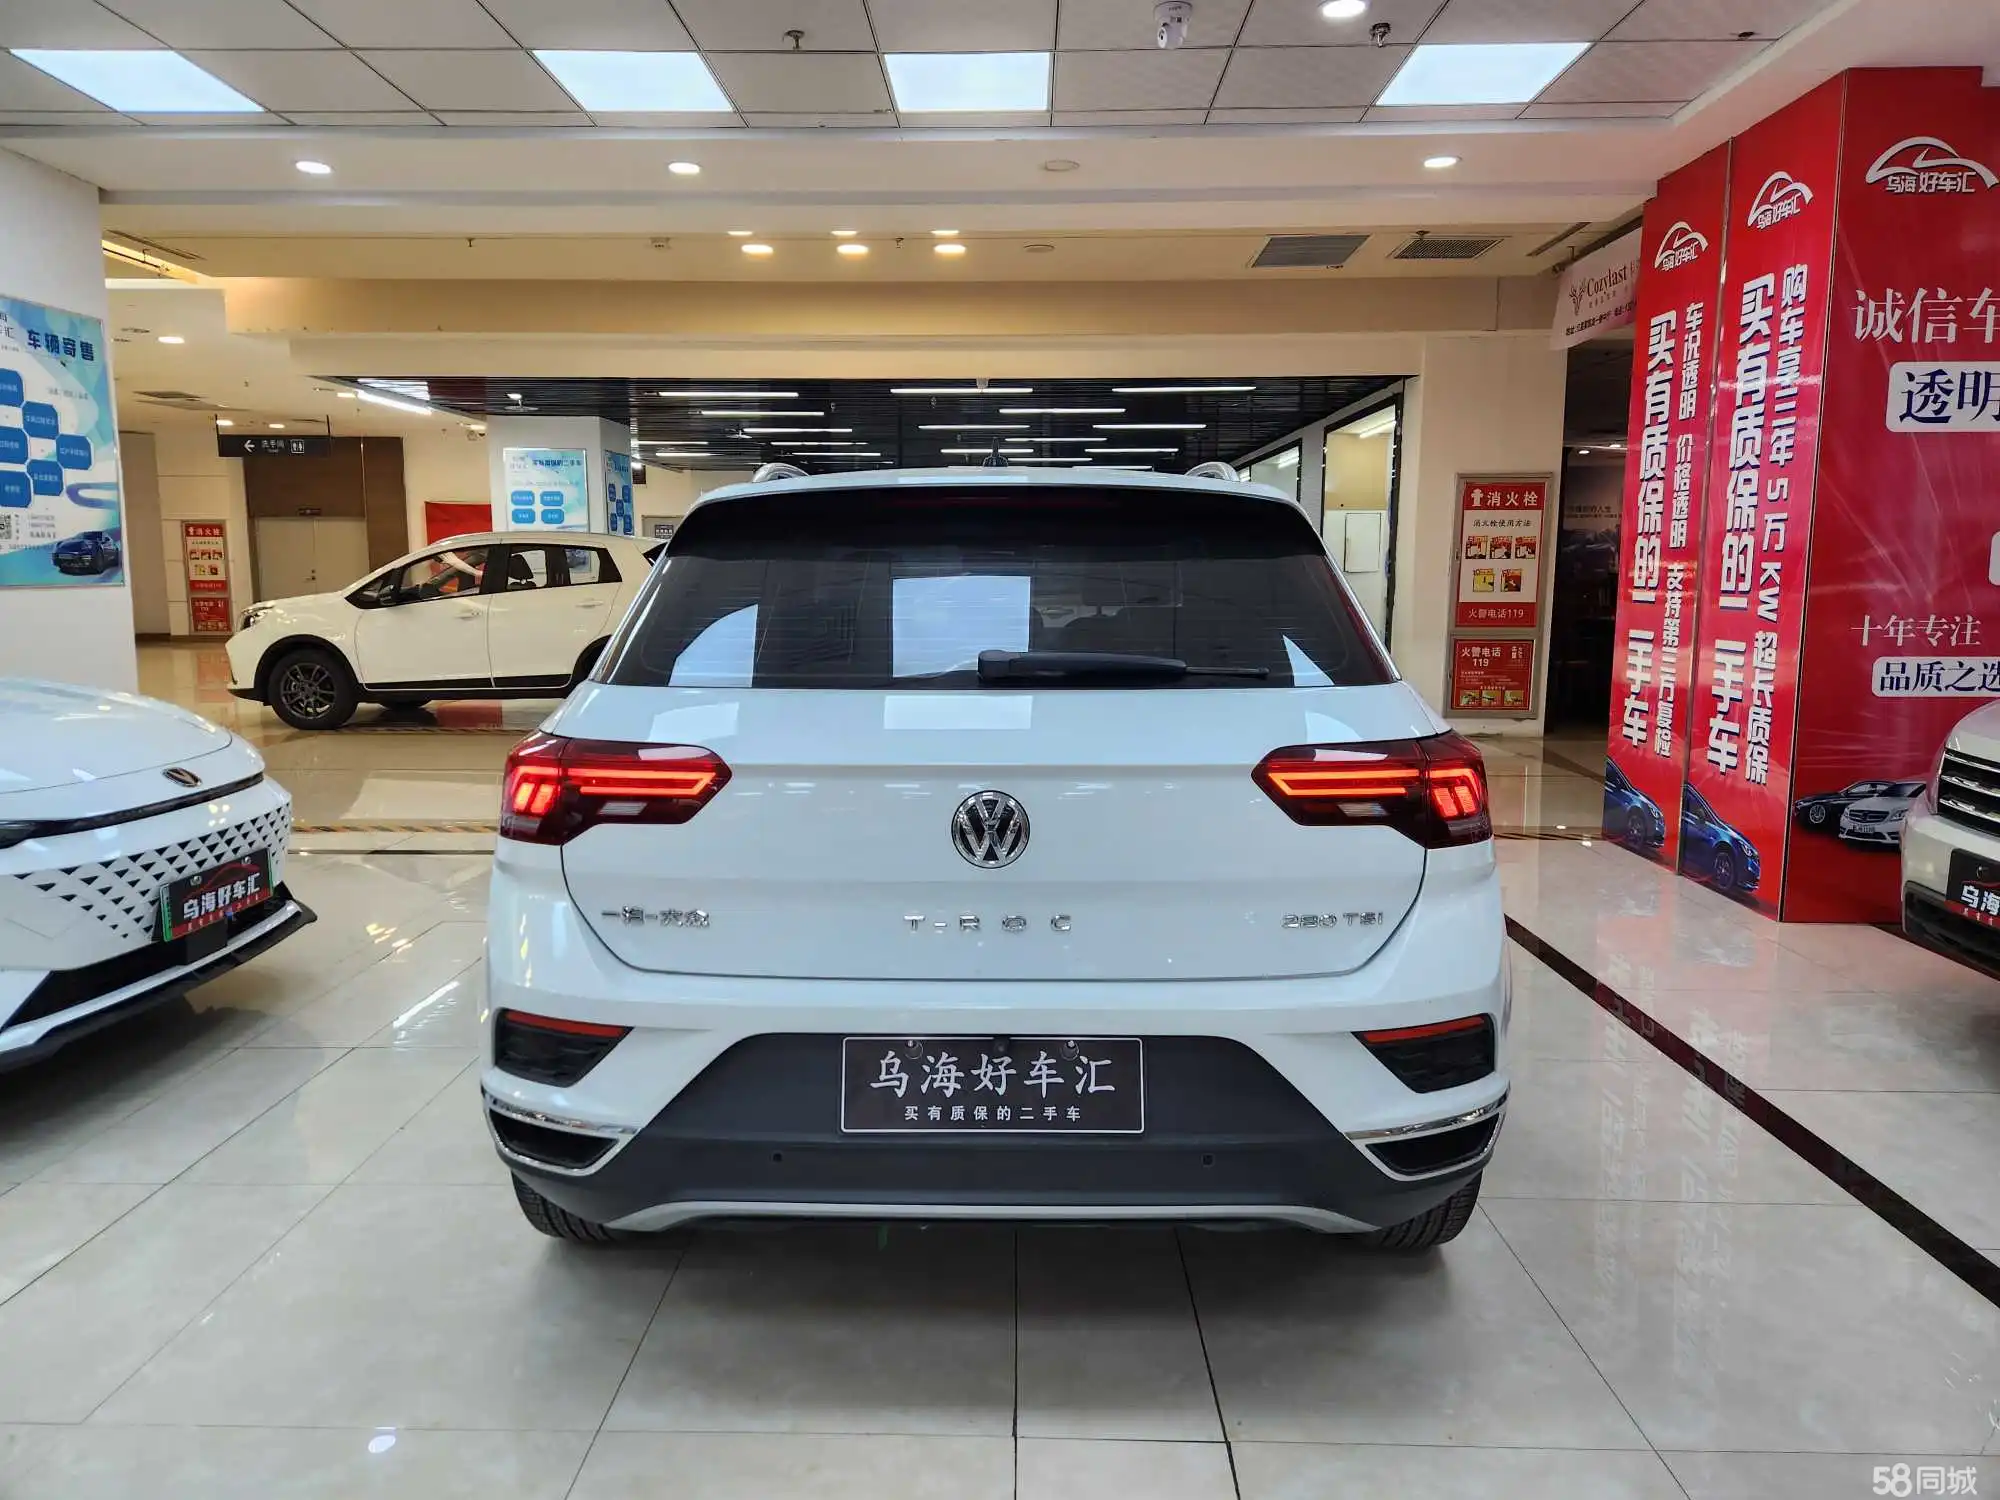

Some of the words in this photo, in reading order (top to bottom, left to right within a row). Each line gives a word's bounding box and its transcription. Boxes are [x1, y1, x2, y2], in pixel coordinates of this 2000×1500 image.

[1884, 171, 1977, 193] 乌海好车汇
[1757, 192, 1802, 229] 乌海好车汇
[1587, 265, 1627, 297] Cozylast
[27, 328, 94, 361] 车辆寄售
[1678, 302, 1704, 420] 车况透明
[1899, 368, 2000, 423] 透明
[1486, 489, 1538, 507] 消火栓
[1668, 434, 1693, 548] 价格透明
[1473, 518, 1532, 528] 消火栓使用方法
[1622, 310, 1677, 748] 买有质保的二手车
[1707, 273, 1774, 775] 买有质保的二手车
[1850, 614, 1982, 647] 十年专注
[1461, 646, 1501, 658] 火警电话
[1472, 658, 1489, 667] 119
[1654, 563, 1685, 758] 支持第三方复检
[1879, 660, 2000, 693] 品质之选
[183, 873, 260, 920] 乌海好车汇
[903, 914, 1072, 932] T-ROC
[1342, 911, 1384, 926] TSI
[869, 1050, 1116, 1099] 乌海好车汇
[903, 1105, 1081, 1122] 买有质保的二手车
